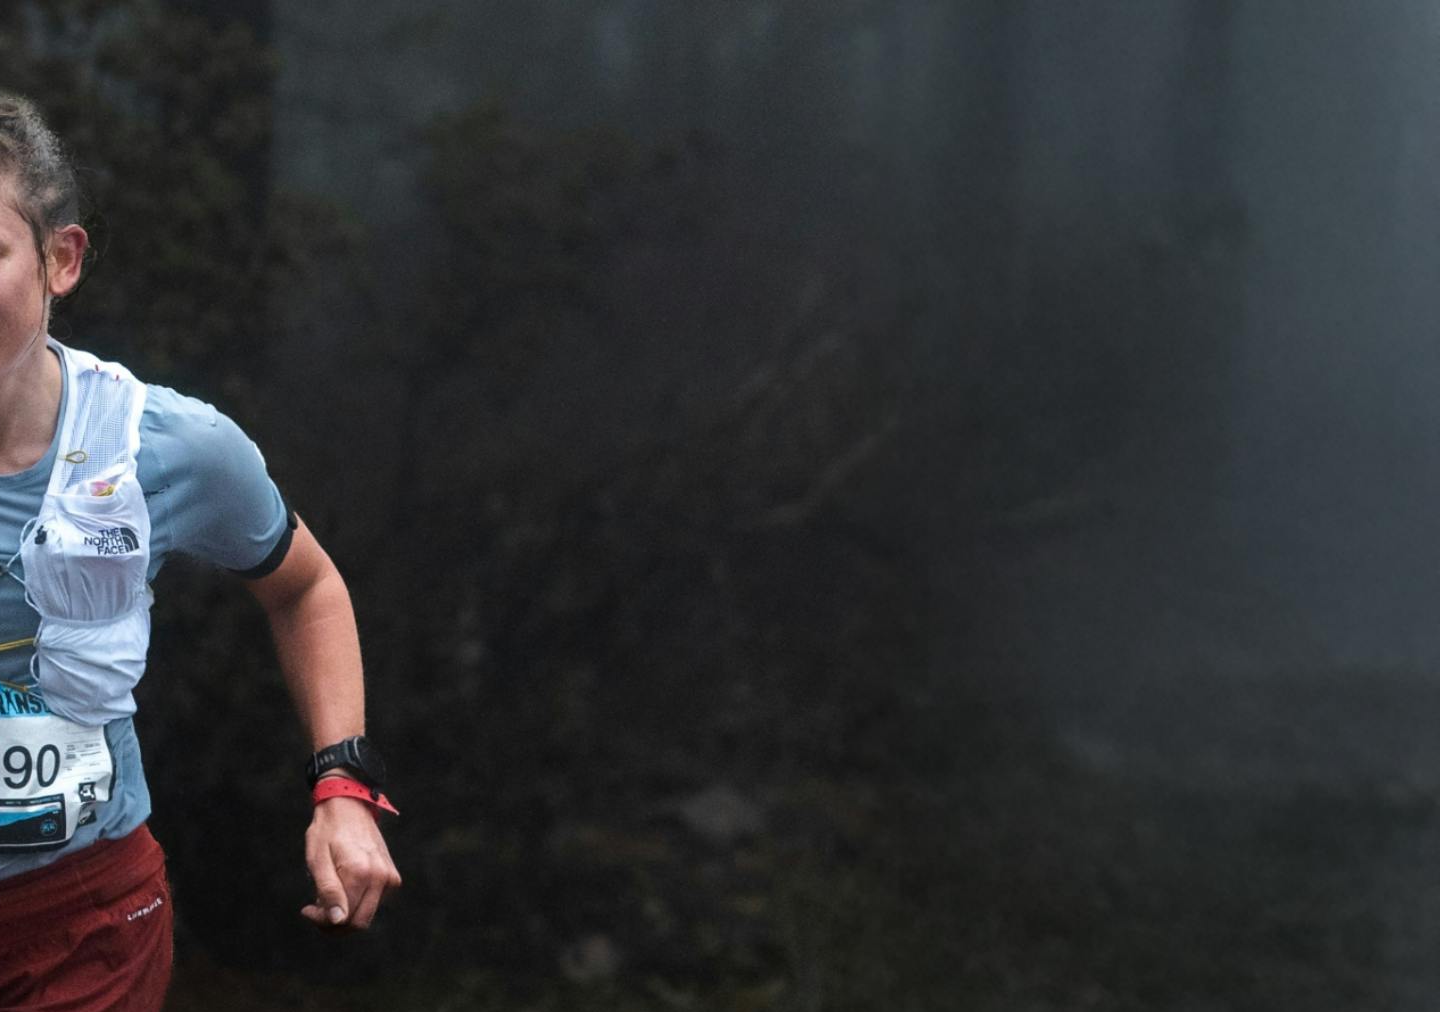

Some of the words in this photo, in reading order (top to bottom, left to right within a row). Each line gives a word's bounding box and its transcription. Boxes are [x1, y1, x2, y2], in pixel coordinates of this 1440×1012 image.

[98, 528, 120, 538] THE
[84, 535, 123, 546] NORTH
[97, 545, 125, 555] FACE
